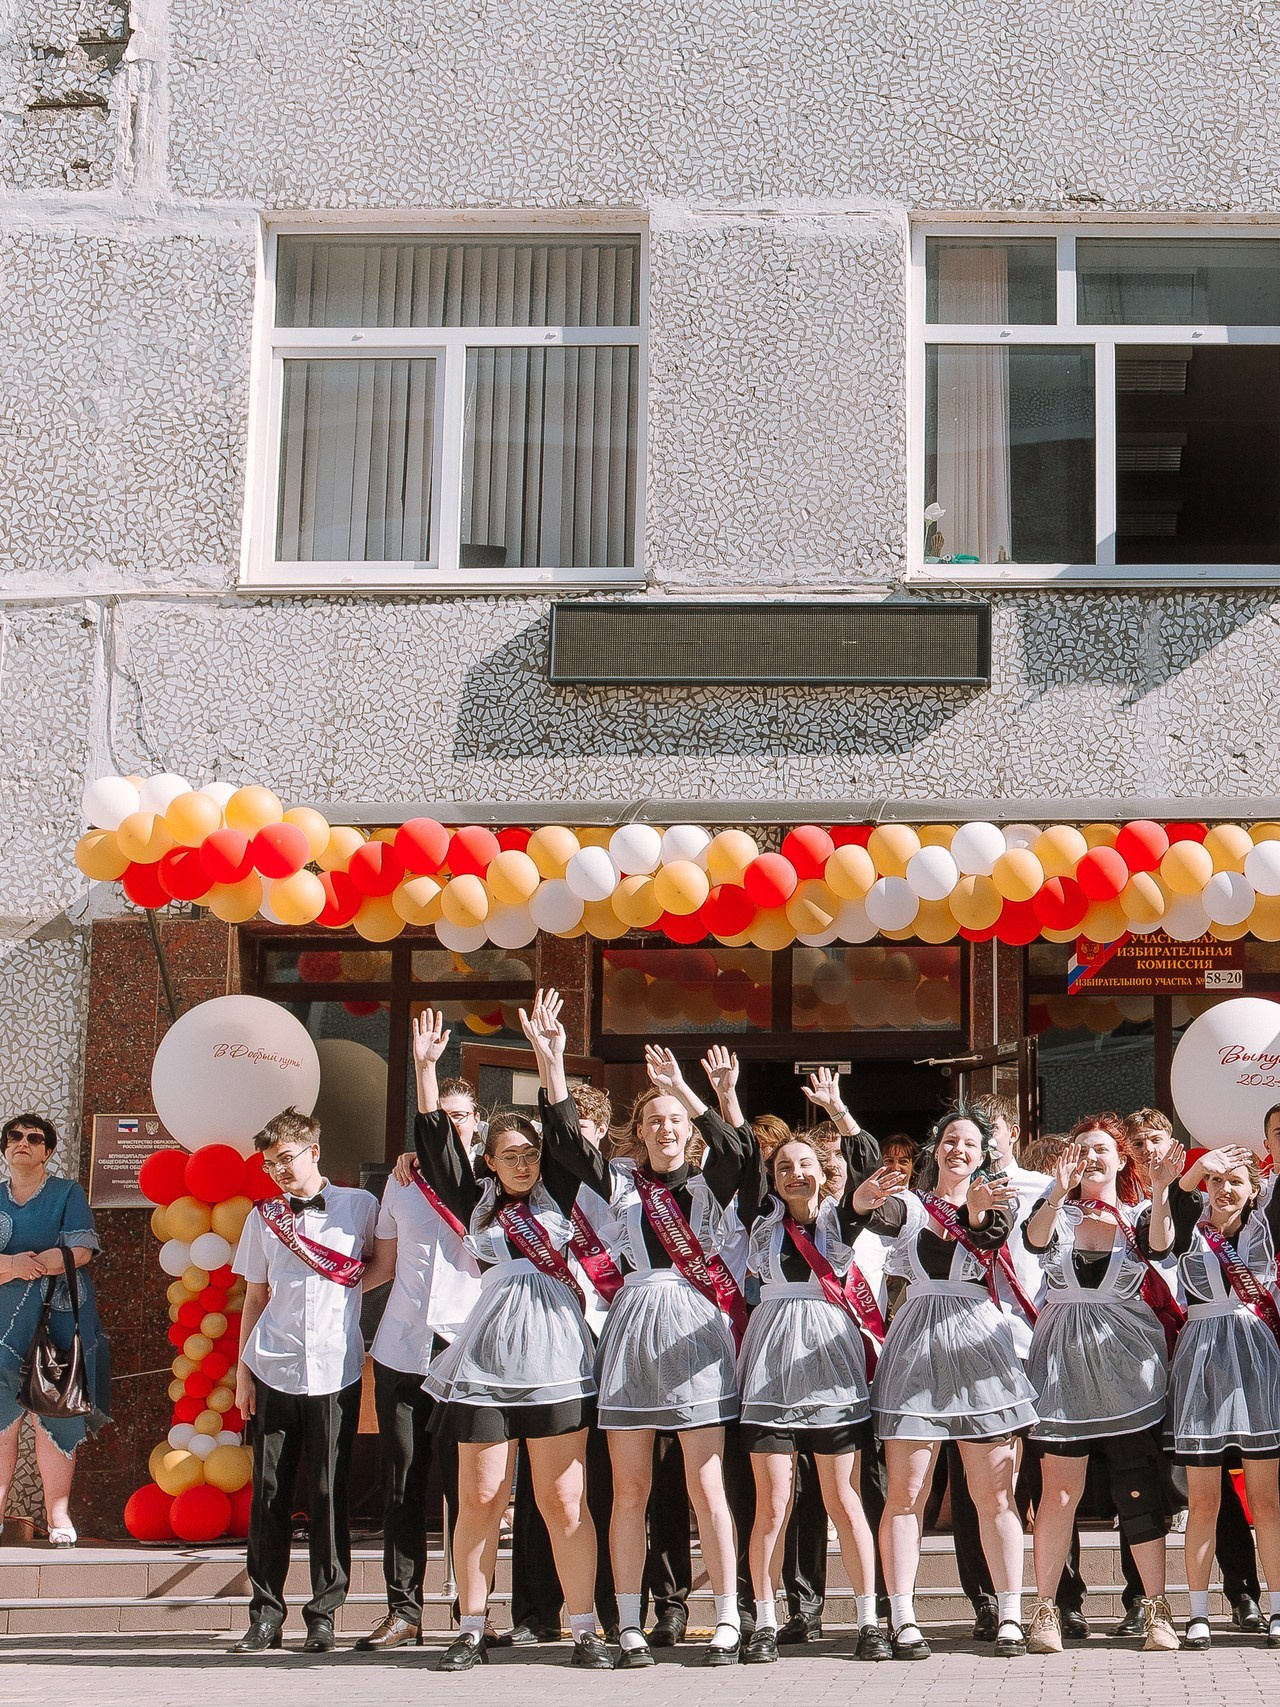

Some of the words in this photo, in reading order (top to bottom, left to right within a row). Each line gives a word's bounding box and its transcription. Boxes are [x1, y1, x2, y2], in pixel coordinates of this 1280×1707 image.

[1131, 934, 1218, 944] УЧАСТВАЯ
[1117, 947, 1233, 957] ИЗБИРАТЕЛЬНАЯ
[1137, 959, 1213, 970] КОМИССИЯ
[1075, 978, 1152, 987] ИЗБИРАТЕЛЬНОГО
[1155, 977, 1192, 986] УЧАСТКА
[1206, 972, 1242, 984] 58-20
[212, 1043, 229, 1058] В
[646, 1181, 692, 1258] Выпускница
[708, 1263, 738, 1297] 2024
[850, 1280, 877, 1313] 2024
